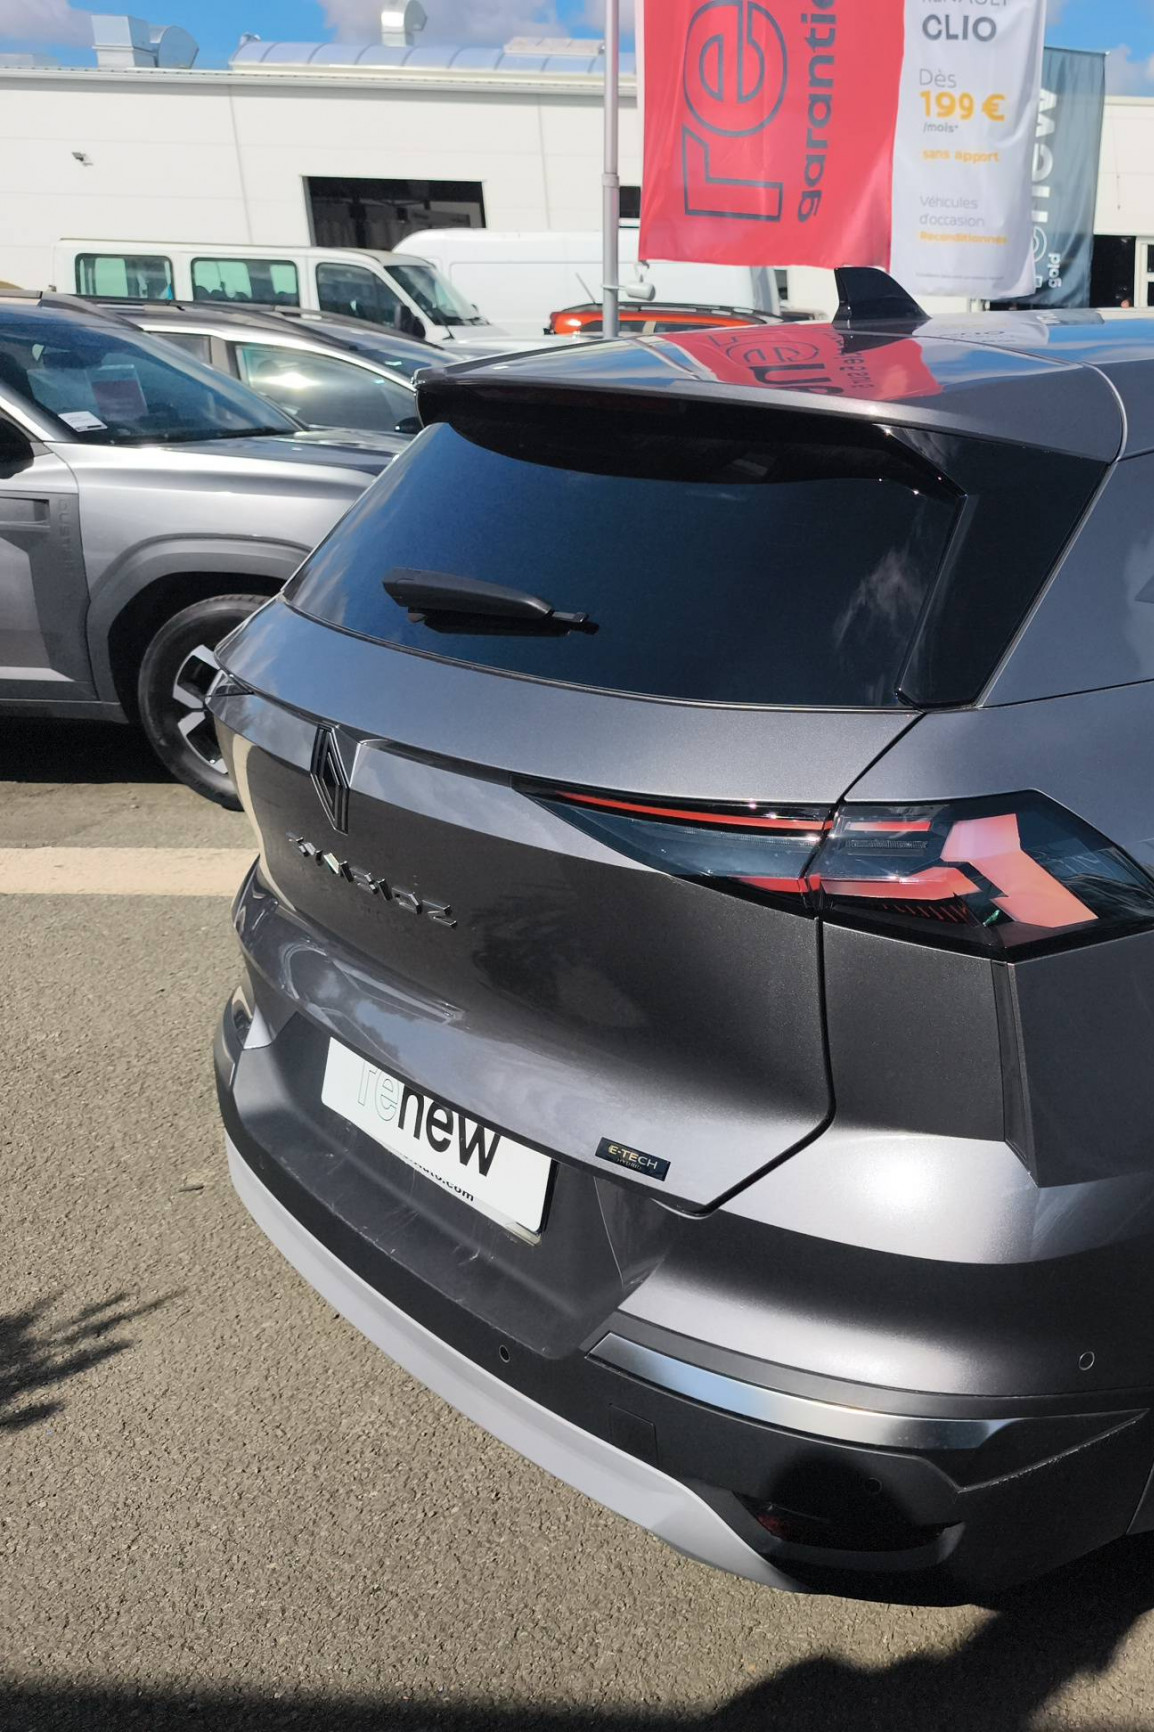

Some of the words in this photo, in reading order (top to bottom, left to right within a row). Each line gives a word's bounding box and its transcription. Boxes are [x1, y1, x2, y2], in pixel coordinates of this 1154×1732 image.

[922, 14, 997, 42] CLIO
[919, 68, 957, 88] Dès
[920, 90, 975, 121] 199
[982, 93, 1006, 122] €
[1048, 253, 1062, 288] gold
[357, 1060, 502, 1177] renew
[608, 1144, 659, 1170] E-TECH
